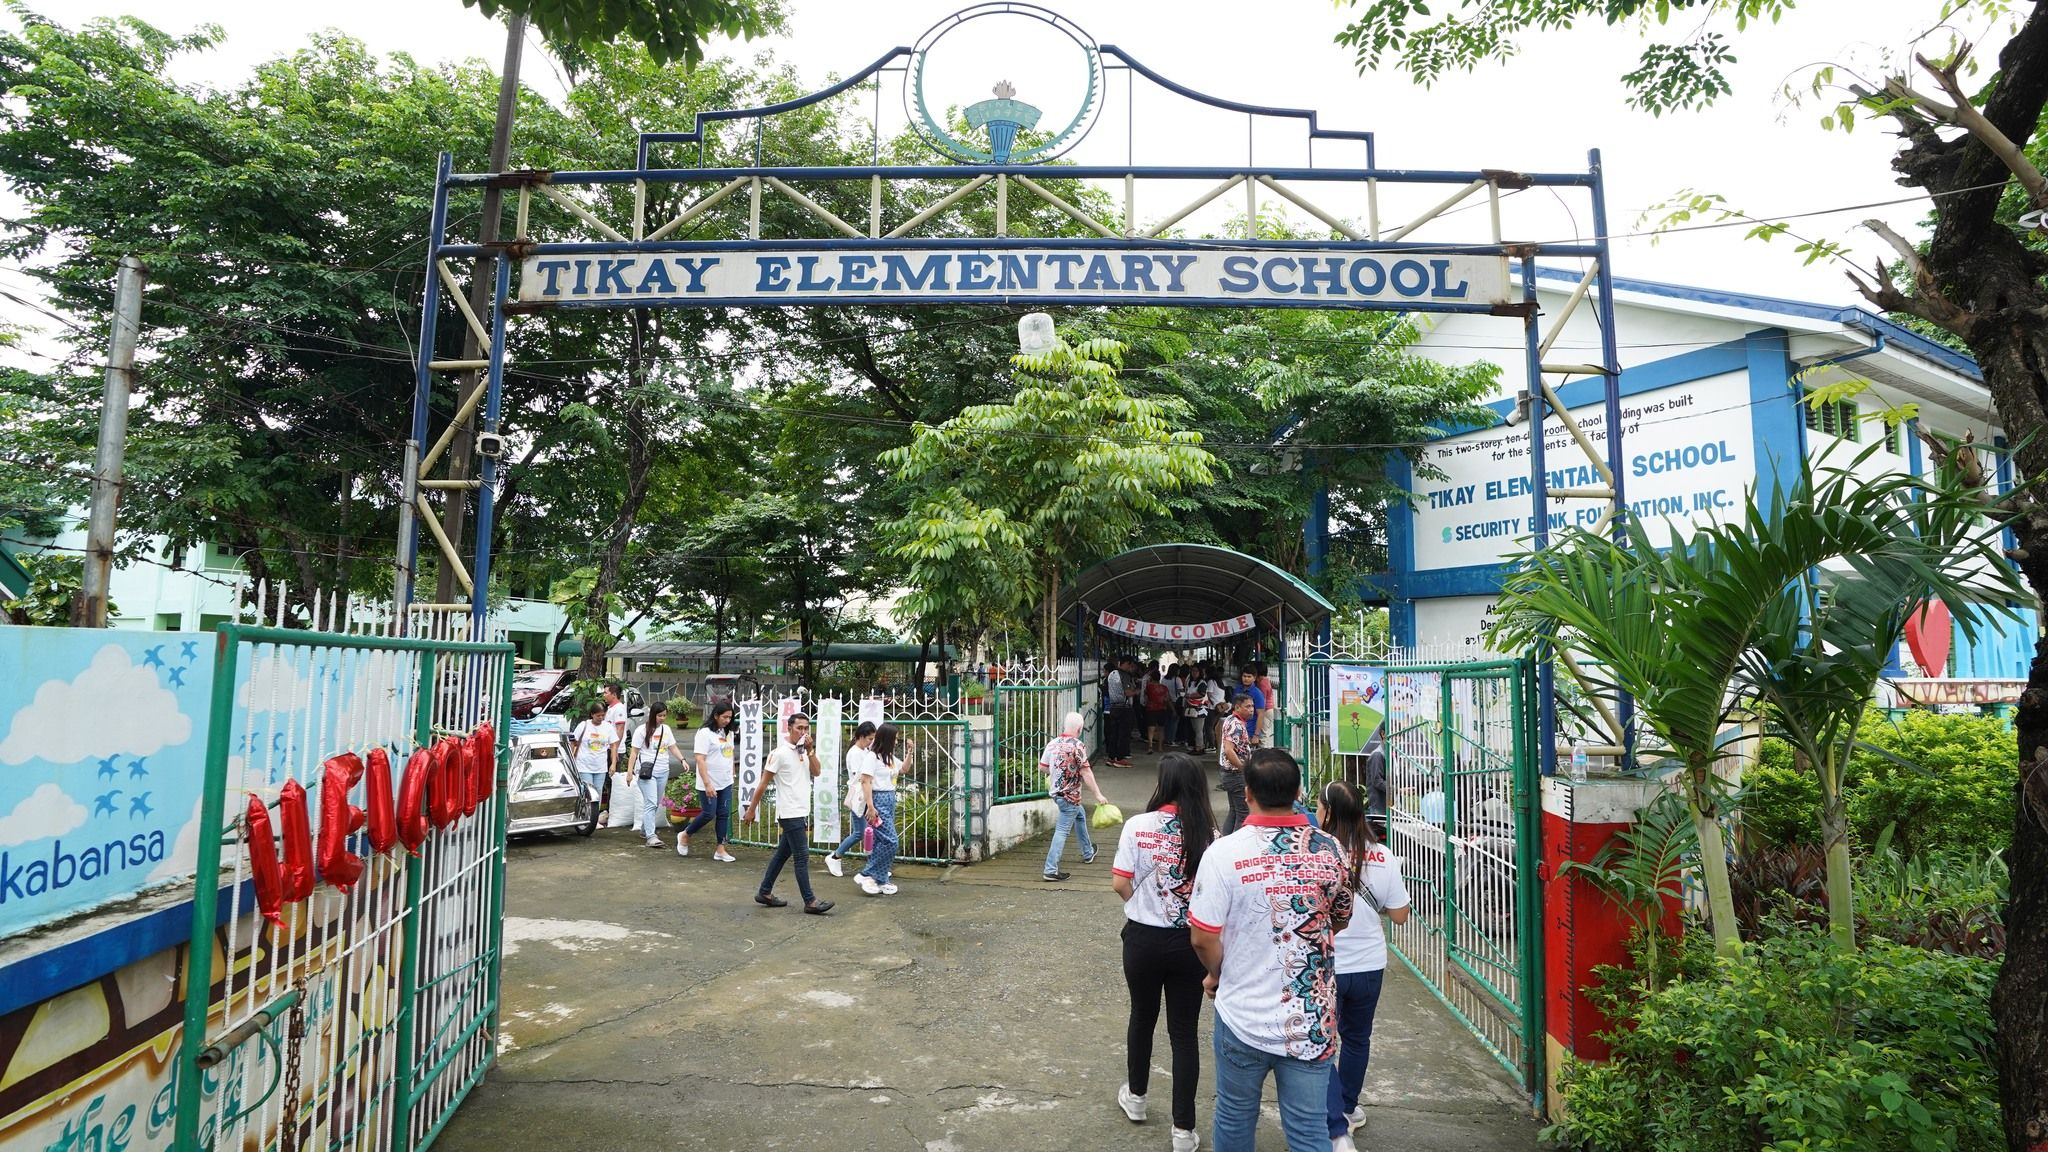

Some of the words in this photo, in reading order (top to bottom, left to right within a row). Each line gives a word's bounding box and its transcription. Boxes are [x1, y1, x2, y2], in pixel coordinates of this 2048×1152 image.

[536, 257, 720, 295] TIKAY
[755, 254, 1199, 293] ELEMENTARY
[1219, 256, 1468, 298] SCHOOL
[1437, 449, 1453, 459] This
[1574, 415, 1602, 429] chool
[1643, 403, 1665, 415] was
[1668, 394, 1694, 409] built
[1492, 452, 1506, 461] for
[1508, 448, 1523, 459] the
[1628, 422, 1640, 434] of
[1428, 485, 1475, 509] TIKAY
[1486, 462, 1610, 501] ELEMENTAR
[1632, 440, 1736, 477] SCHOOL
[1456, 518, 1521, 542] SECURITY
[1528, 512, 1567, 532] BNK
[1693, 489, 1735, 511] INC.
[1103, 612, 1249, 639] WELCOME
[1135, 831, 1170, 841] BRIGADA
[1137, 841, 1162, 850] ADOPT
[0, 830, 164, 904] kabansa
[1235, 856, 1282, 870] BRIGADA
[1241, 871, 1277, 884] ADOPT
[1265, 885, 1318, 895] PROGRAM
